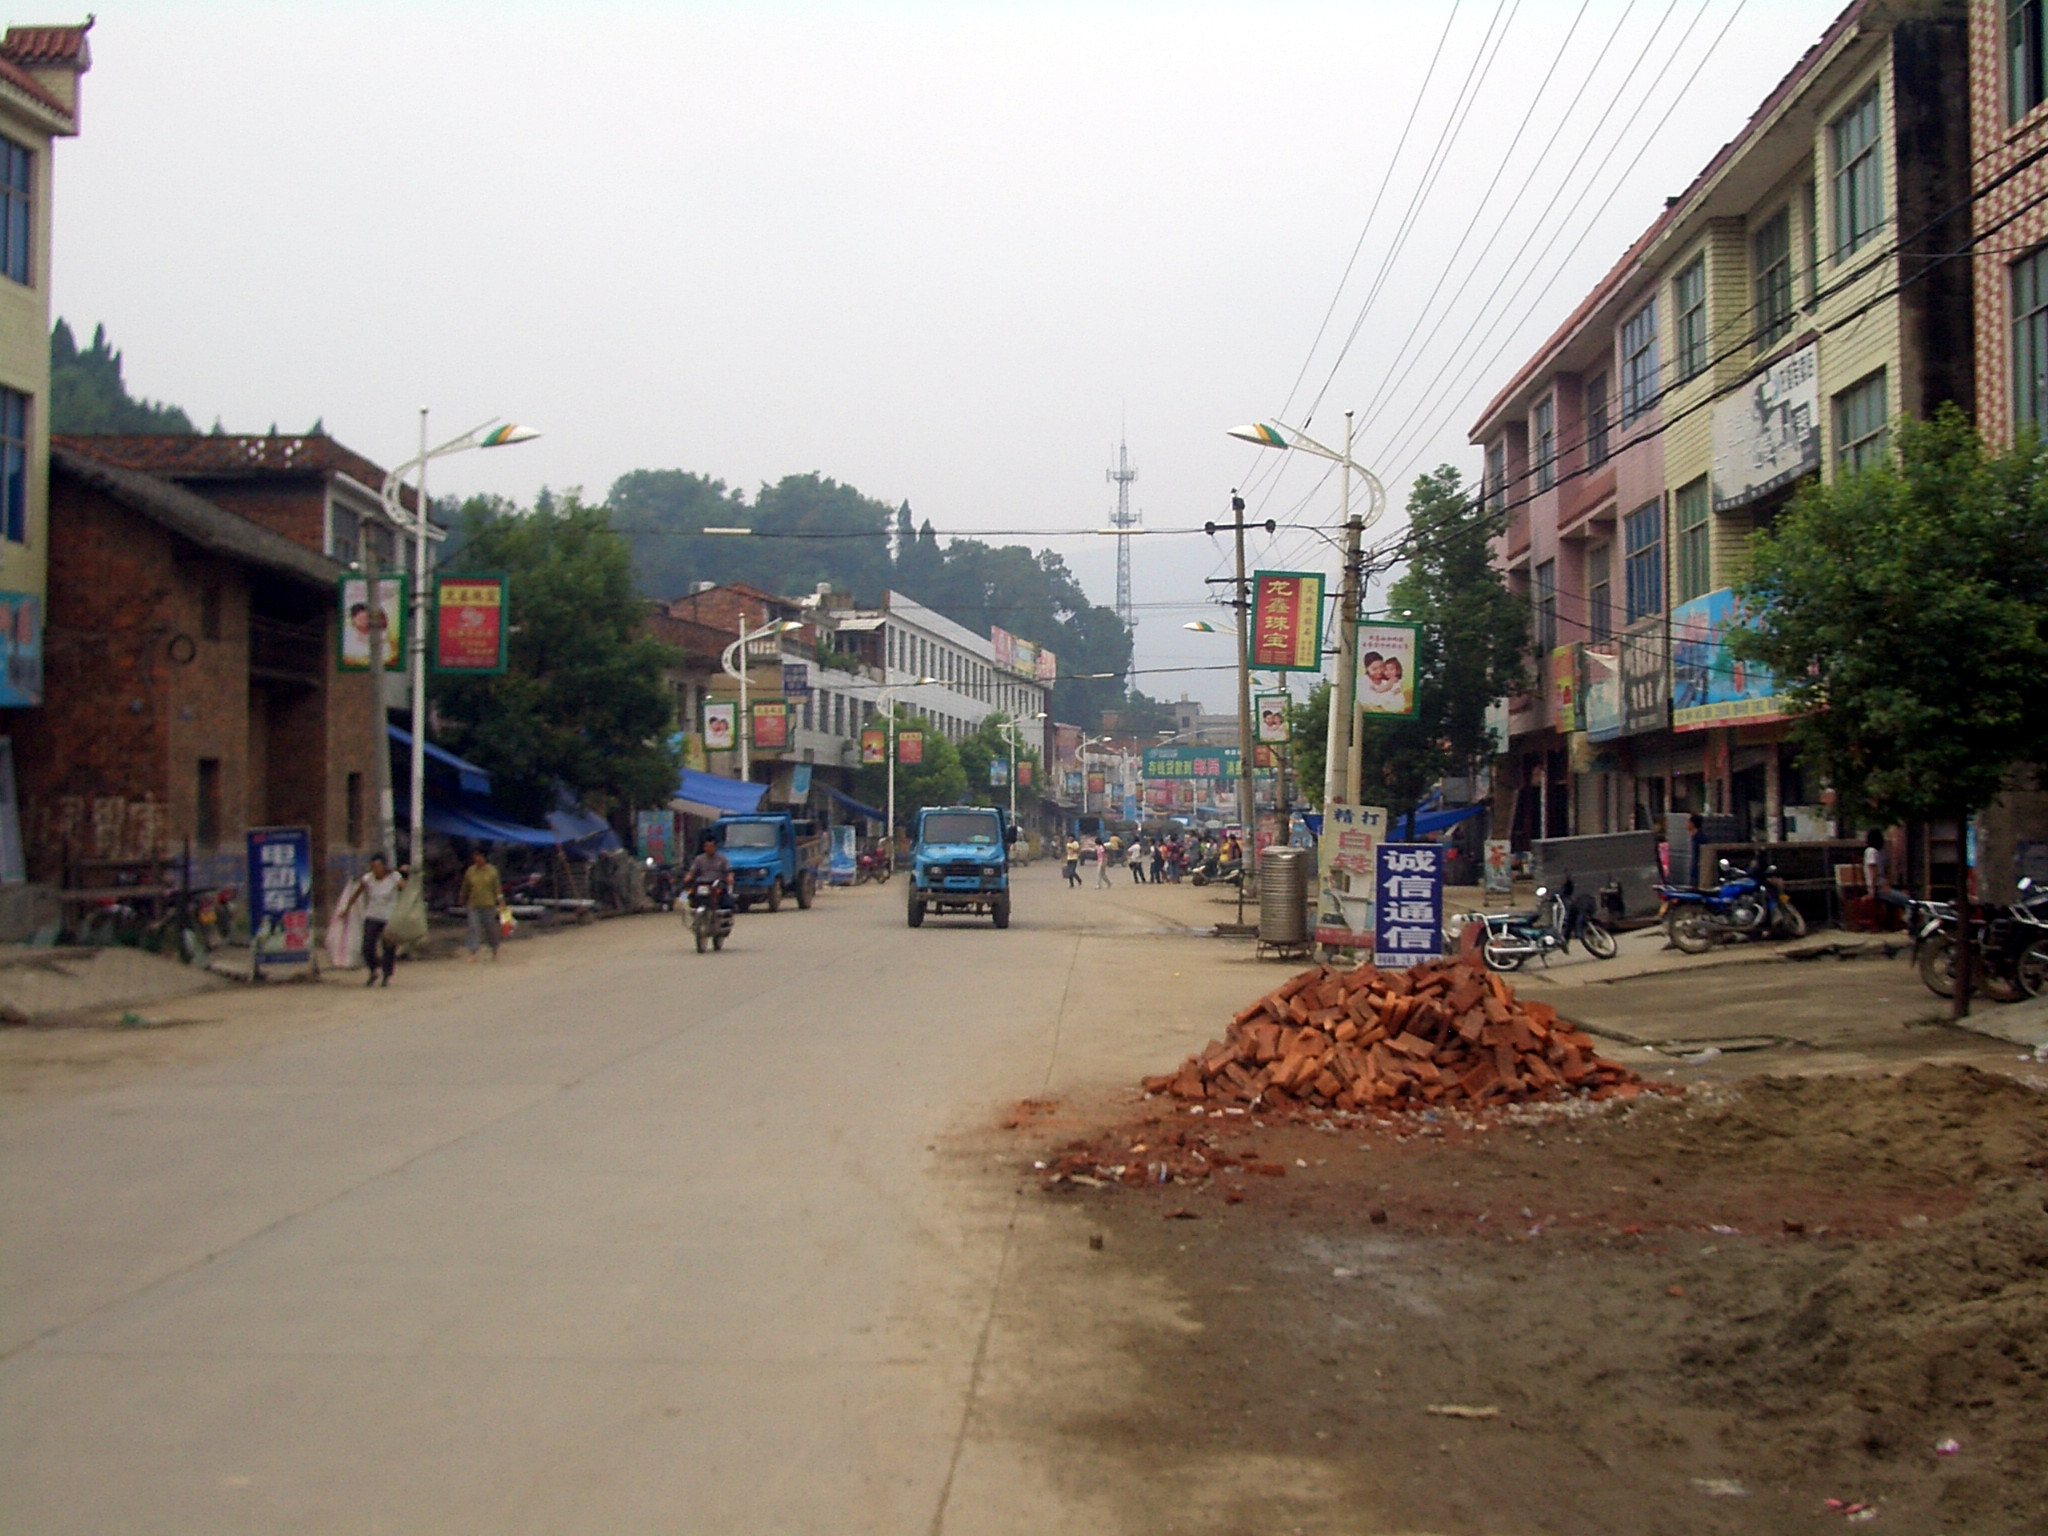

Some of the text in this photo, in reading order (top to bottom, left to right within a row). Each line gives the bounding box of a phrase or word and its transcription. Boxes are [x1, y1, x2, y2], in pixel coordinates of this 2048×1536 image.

[1334, 808, 1380, 826] 精打
[262, 845, 296, 911] 电动车
[1383, 850, 1437, 949] 诚信通信
